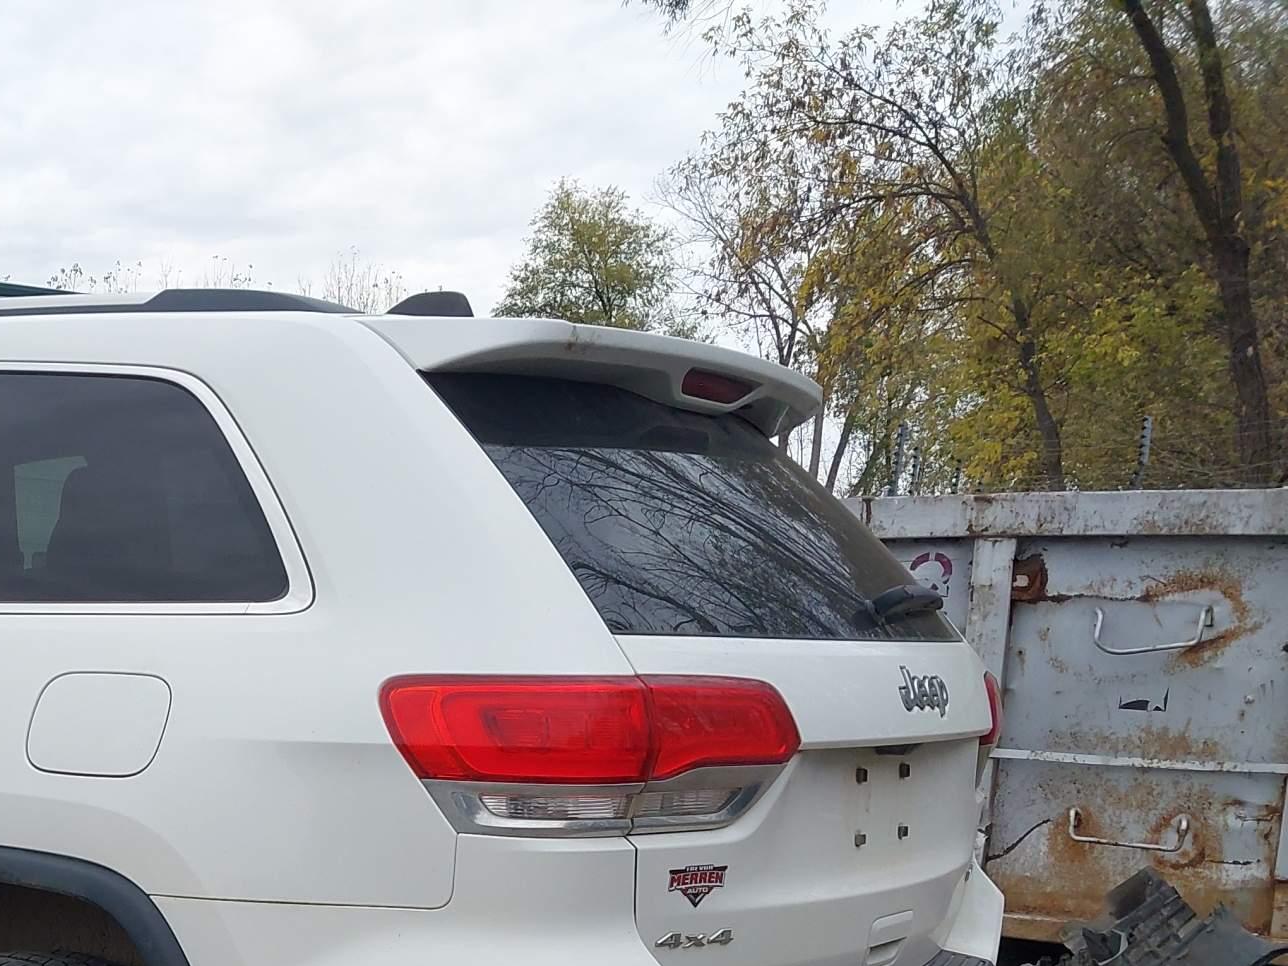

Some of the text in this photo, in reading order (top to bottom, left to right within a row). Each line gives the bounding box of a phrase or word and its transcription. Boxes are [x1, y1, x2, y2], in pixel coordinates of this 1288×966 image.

[898, 664, 949, 718] Jeep
[669, 869, 725, 890] MERREN
[686, 886, 709, 894] AUTO
[654, 928, 734, 949] 4x4
